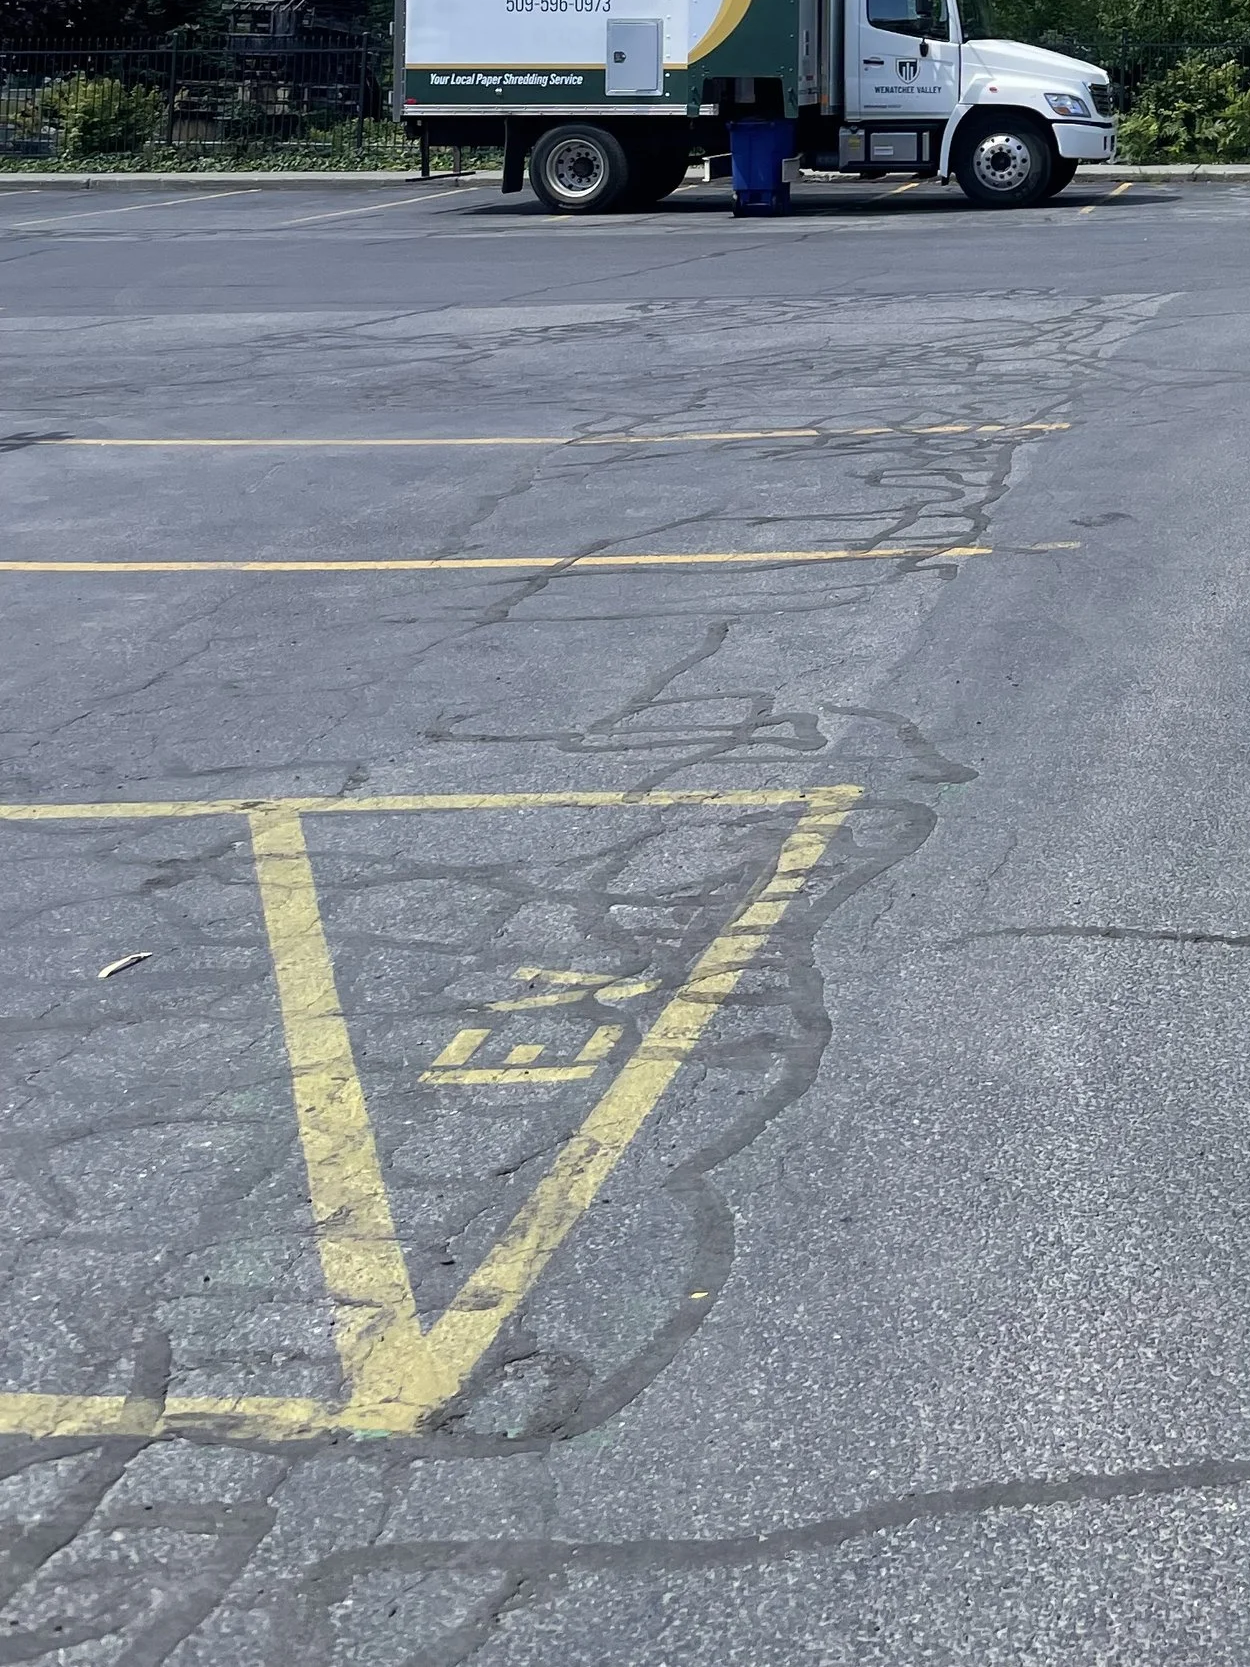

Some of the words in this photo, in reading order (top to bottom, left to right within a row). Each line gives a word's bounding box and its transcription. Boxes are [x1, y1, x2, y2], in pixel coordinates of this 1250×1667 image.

[429, 73, 450, 85] Your
[450, 73, 475, 85] Local
[475, 74, 503, 87] Paper
[503, 73, 549, 87] Shredding
[549, 73, 584, 85] Service
[874, 86, 915, 94] WENATCHEE
[916, 86, 942, 94] VALLEY
